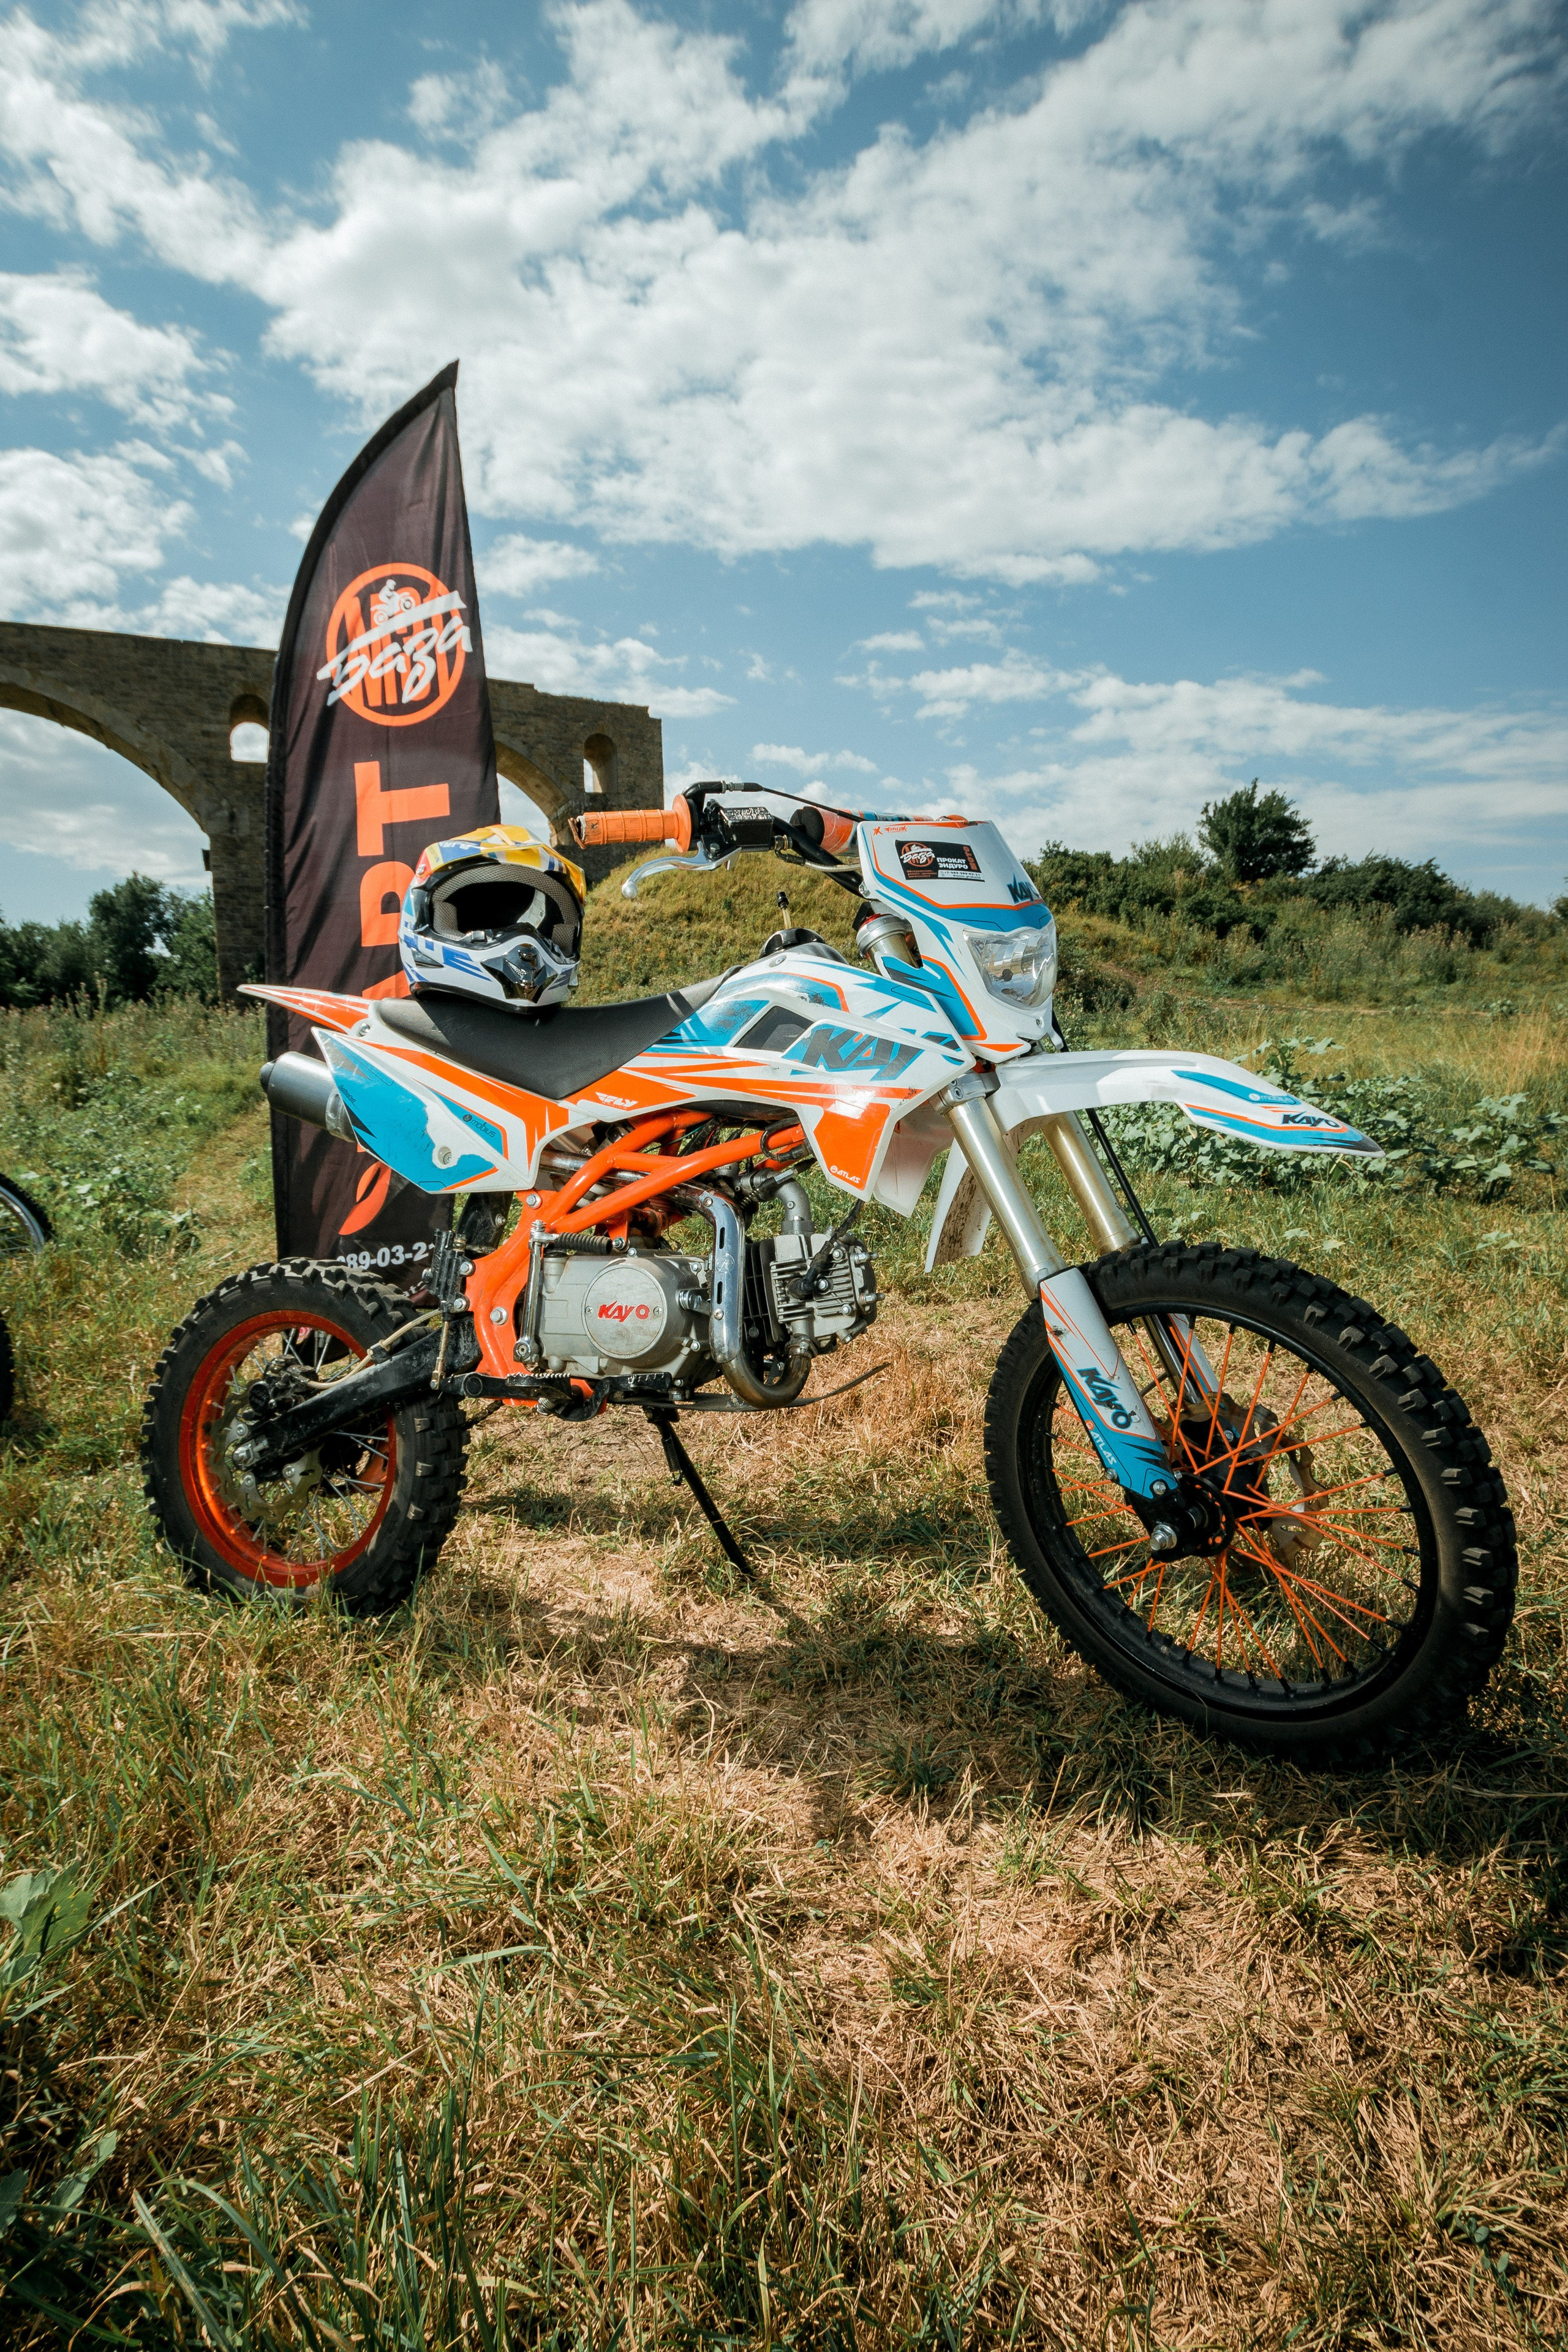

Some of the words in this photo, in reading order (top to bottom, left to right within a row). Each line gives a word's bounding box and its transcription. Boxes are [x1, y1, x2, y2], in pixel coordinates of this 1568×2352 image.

[1281, 1110, 1342, 1128] KAYO
[837, 1170, 861, 1183] ATLAS
[337, 1242, 435, 1270] 89-03-2
[598, 1300, 650, 1323] KAYO
[1077, 1367, 1133, 1430] KAYO
[1090, 1431, 1117, 1465] ATLAS
